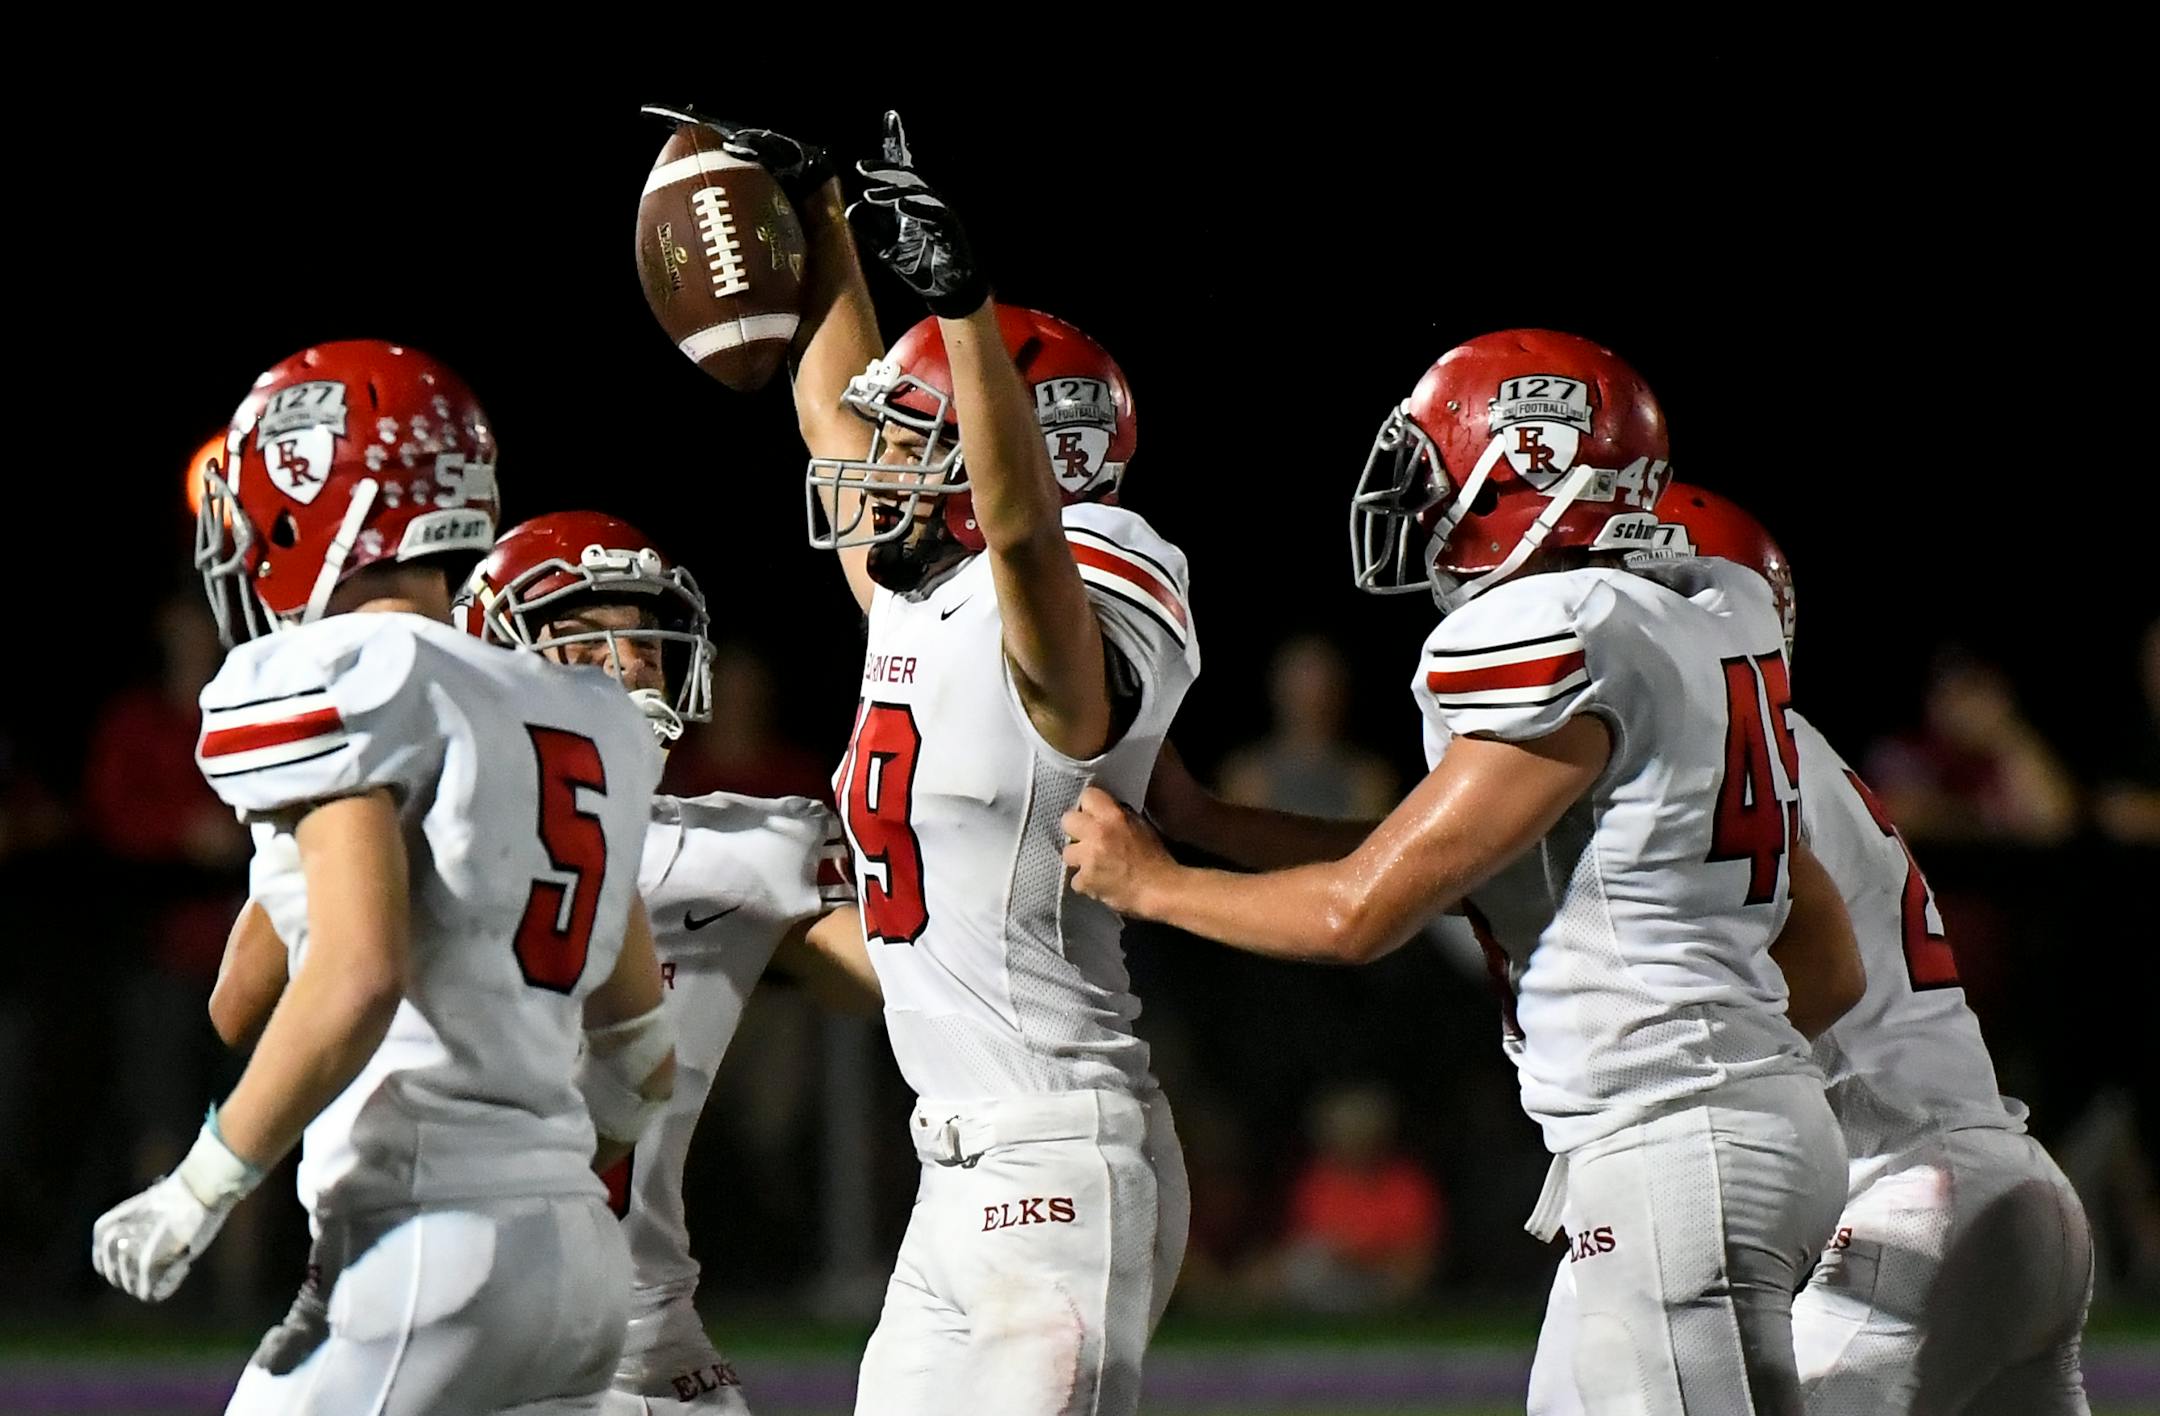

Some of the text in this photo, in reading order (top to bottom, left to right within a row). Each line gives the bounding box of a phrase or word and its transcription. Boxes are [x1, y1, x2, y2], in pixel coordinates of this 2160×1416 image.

[274, 385, 333, 414] 127
[1043, 380, 1100, 406] 127
[1508, 378, 1577, 401] 127
[1519, 402, 1566, 416] FOOTBALL
[1053, 431, 1093, 478] ER
[1513, 426, 1562, 474] ER
[513, 722, 608, 997] 5
[982, 1197, 1077, 1232] ELKS
